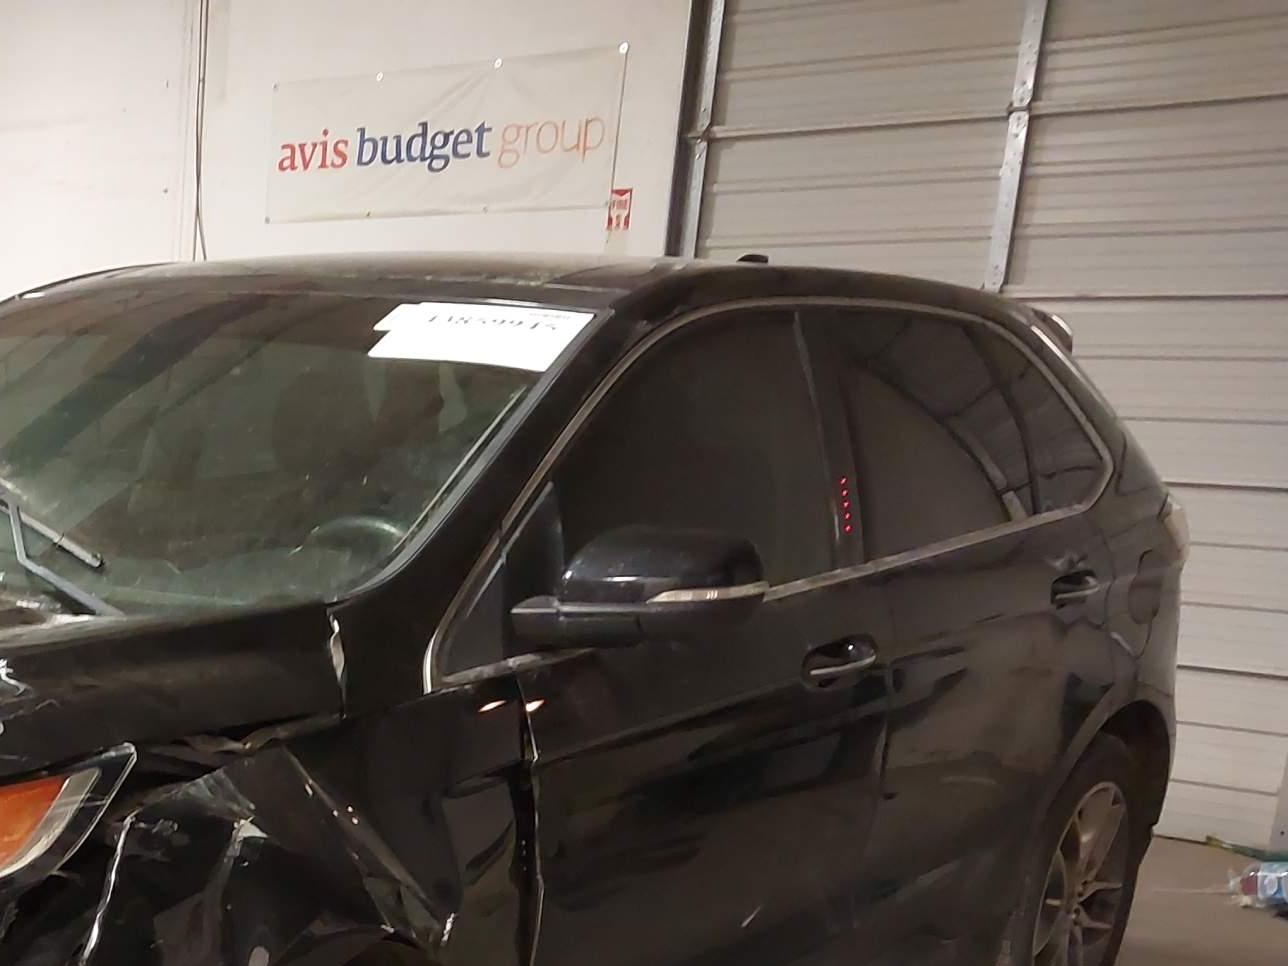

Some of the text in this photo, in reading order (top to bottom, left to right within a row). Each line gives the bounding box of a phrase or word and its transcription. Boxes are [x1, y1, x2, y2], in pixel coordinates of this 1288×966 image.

[278, 116, 606, 173] avis budget group
